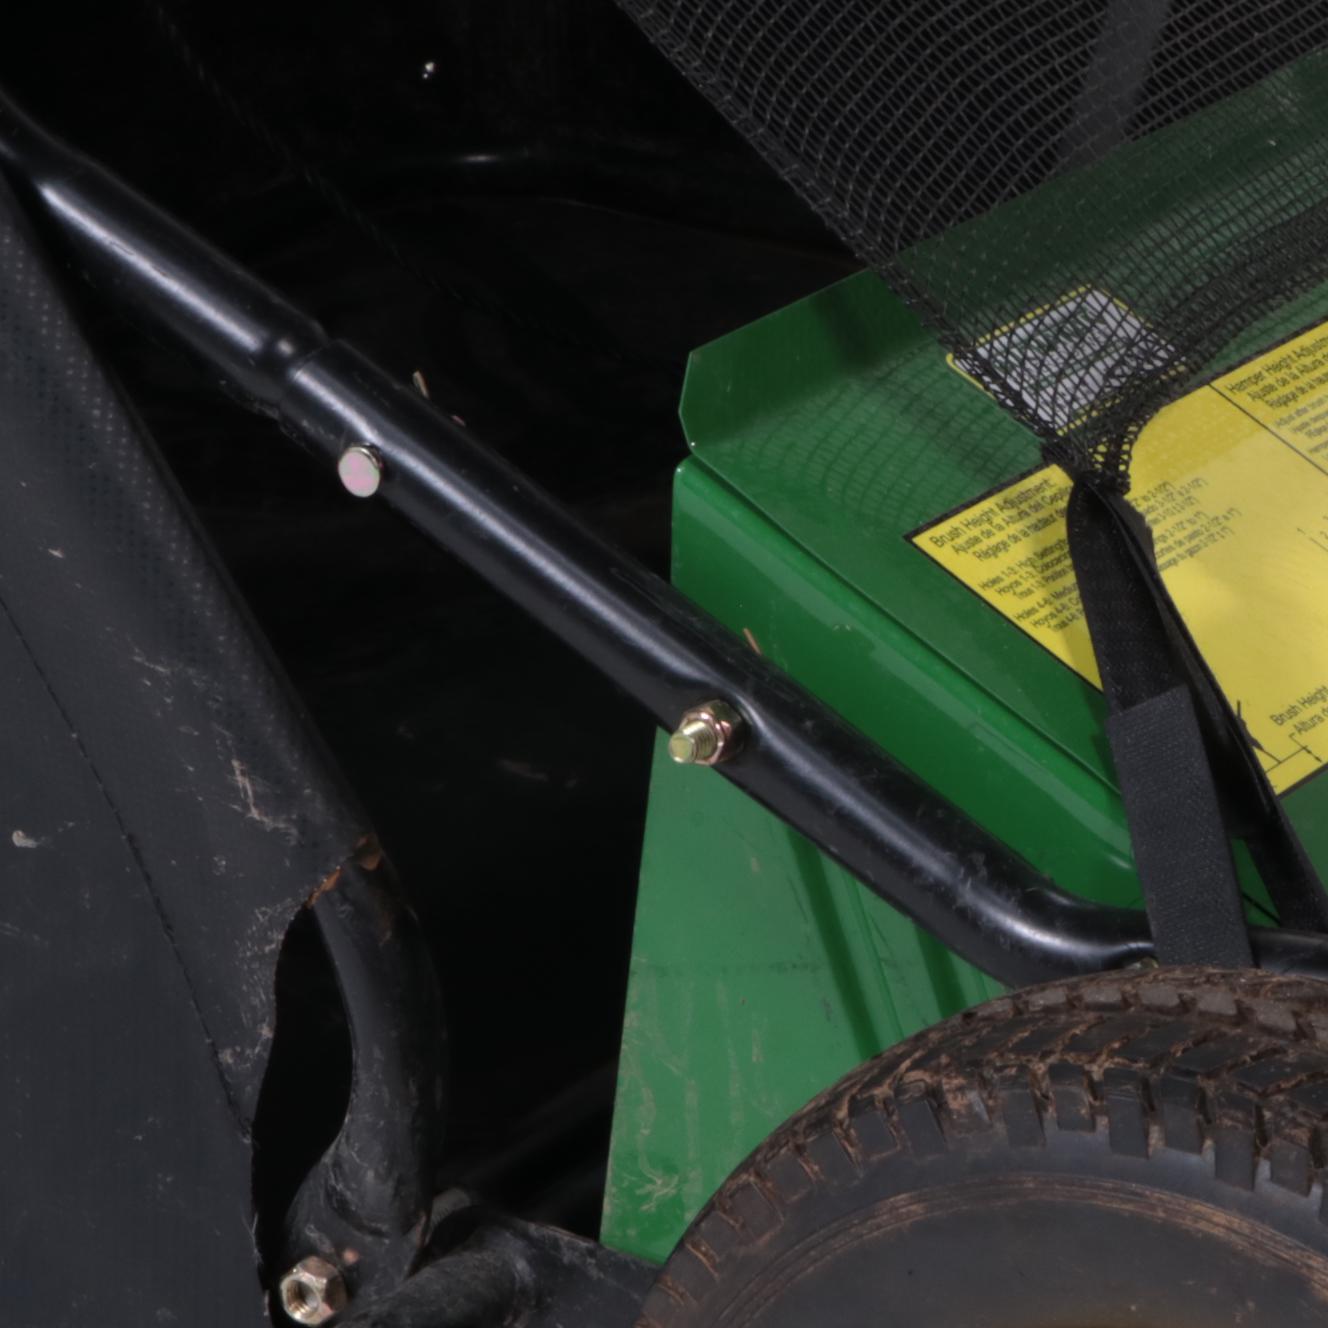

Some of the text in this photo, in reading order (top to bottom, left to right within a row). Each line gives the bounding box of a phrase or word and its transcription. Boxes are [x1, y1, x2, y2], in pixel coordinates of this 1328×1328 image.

[1225, 371, 1266, 395] Hamper
[1262, 354, 1298, 376] Height
[1028, 500, 1045, 513] del
[929, 526, 967, 548] Brush
[960, 507, 1000, 531] Height
[1269, 705, 1302, 726] Brush
[1292, 714, 1325, 735] Altura
